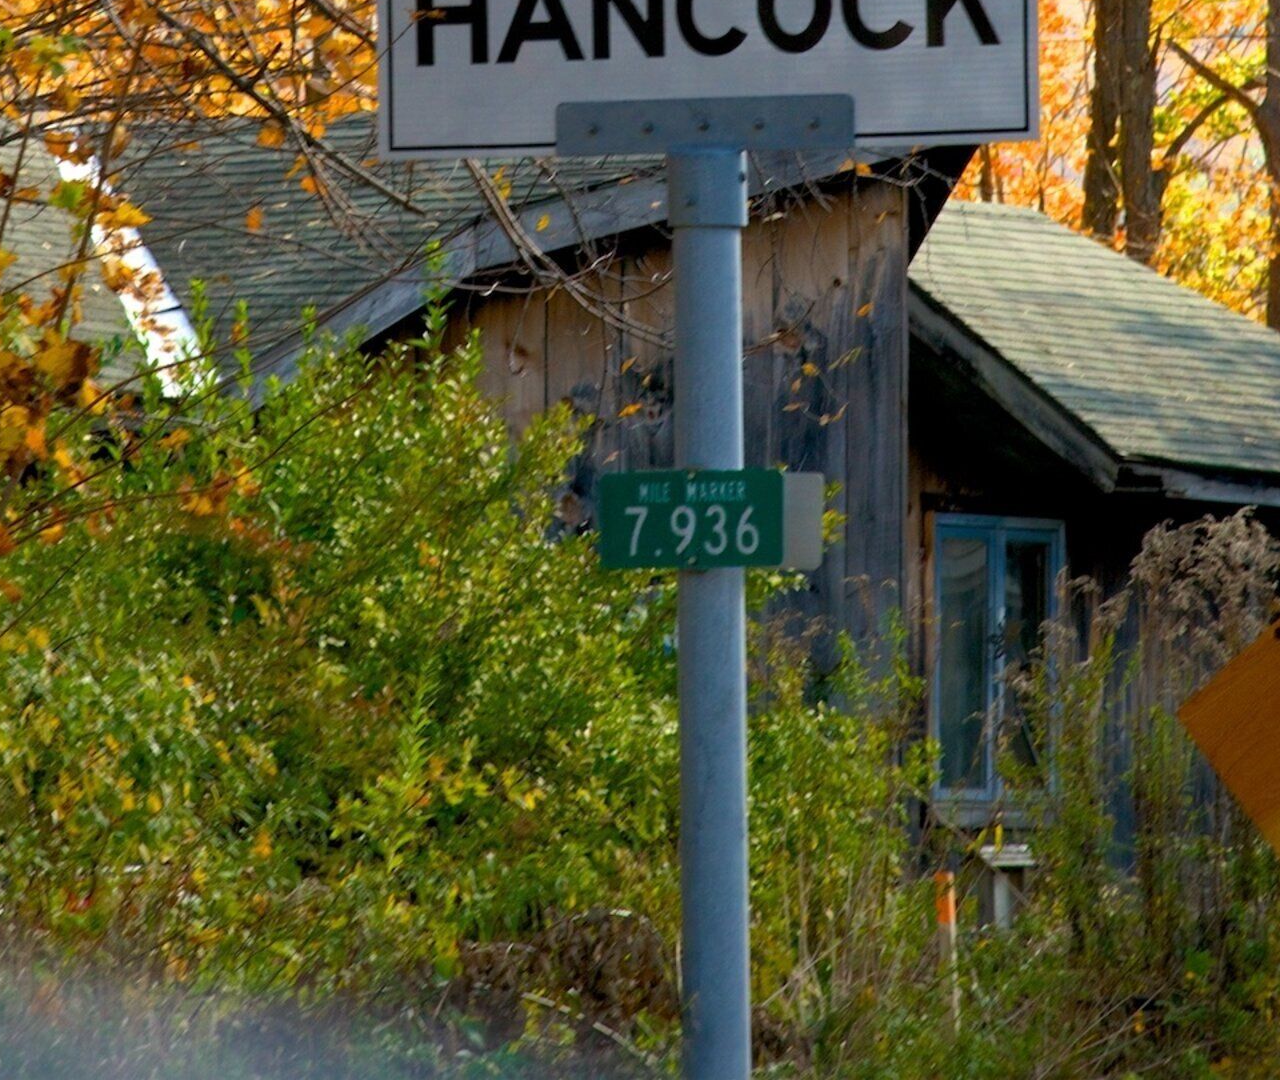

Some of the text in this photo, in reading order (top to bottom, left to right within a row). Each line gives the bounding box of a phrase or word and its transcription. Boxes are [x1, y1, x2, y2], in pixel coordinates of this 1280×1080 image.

[638, 480, 746, 503] MILE MARKER
[624, 505, 760, 557] 7.936
